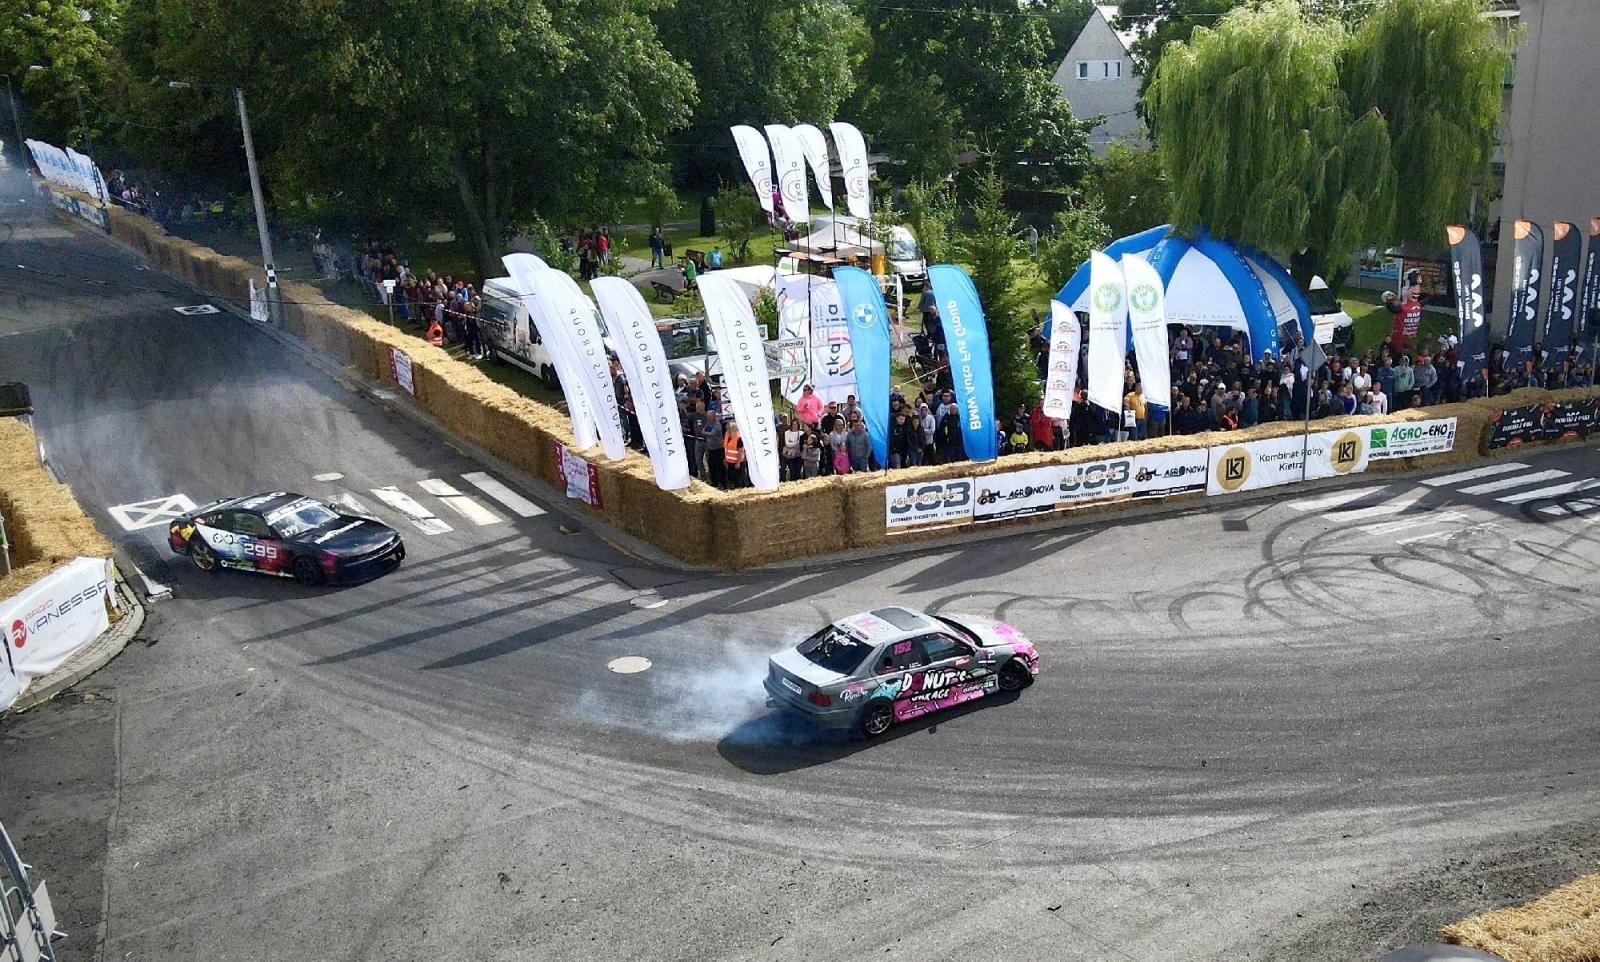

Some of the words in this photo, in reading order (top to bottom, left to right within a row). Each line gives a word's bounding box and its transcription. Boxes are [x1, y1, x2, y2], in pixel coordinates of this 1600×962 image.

[1259, 450, 1299, 463] Kombinat
[1278, 460, 1305, 472] Kietrz
[1007, 484, 1056, 500] AGRONOVA
[243, 542, 279, 560] 299
[25, 599, 55, 621] RADIO
[893, 640, 913, 656] 152
